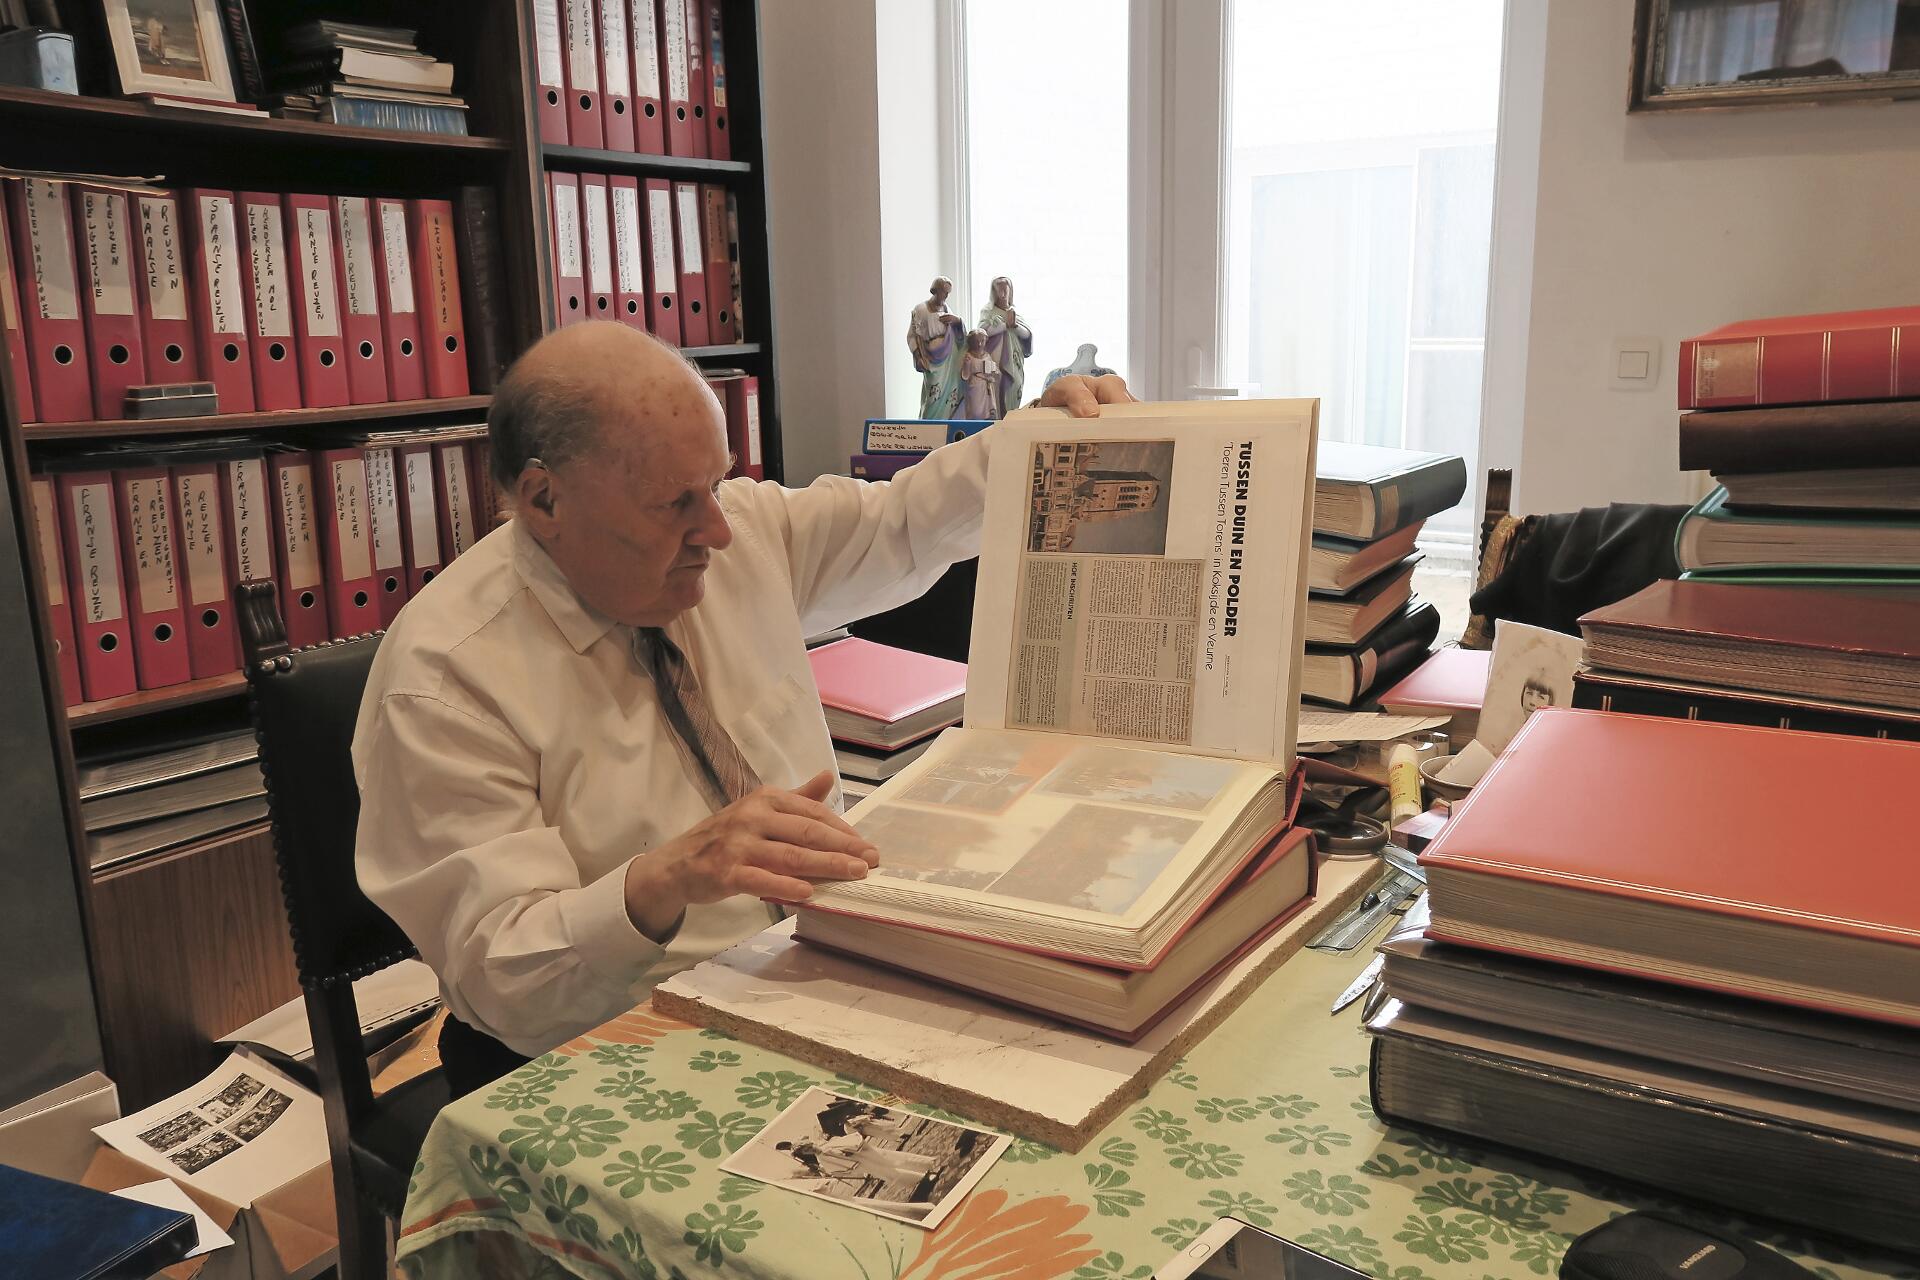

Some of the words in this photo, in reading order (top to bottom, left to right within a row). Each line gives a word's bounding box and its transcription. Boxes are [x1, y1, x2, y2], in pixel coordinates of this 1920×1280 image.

[86, 195, 102, 298] BELGISCHE
[106, 195, 119, 266] REUZEN
[141, 204, 157, 288] WAALSE
[160, 205, 179, 290] REUZEN
[210, 199, 222, 274] SPAANSE
[307, 210, 319, 264] FRANSE
[342, 198, 354, 259] FRANSE
[348, 262, 360, 314] REUZEN
[214, 278, 226, 332] REUZEN
[268, 284, 277, 312] MOL
[311, 269, 325, 320] REUZEN
[236, 462, 248, 520] FRANSE
[335, 464, 344, 521] FRANSE
[408, 459, 416, 494] ATH
[1236, 441, 1252, 500] TUSSEN
[131, 482, 142, 546] FRANSE
[182, 478, 196, 550] SPAANSE
[198, 490, 214, 554] REUZEN
[282, 470, 296, 553] BELGISCHE
[297, 484, 310, 542] REUZEN
[349, 486, 360, 539] REUZEN
[1218, 482, 1230, 516] Tussen
[1232, 504, 1246, 544] DUIN
[81, 488, 96, 559] FRANSE
[90, 566, 104, 621] REUZEN
[150, 500, 163, 564] REUZEN
[240, 527, 253, 582] REUZEN
[1230, 549, 1242, 570] EN
[1070, 562, 1078, 577] HOE
[1213, 558, 1223, 568] in
[1067, 578, 1077, 620] INSCHRIJVEN
[1208, 570, 1222, 615] Koksijde
[1224, 574, 1240, 637] POLDER
[1205, 633, 1218, 671] Veurne
[1208, 618, 1216, 630] en
[1680, 1244, 1716, 1269] VANGUARD
